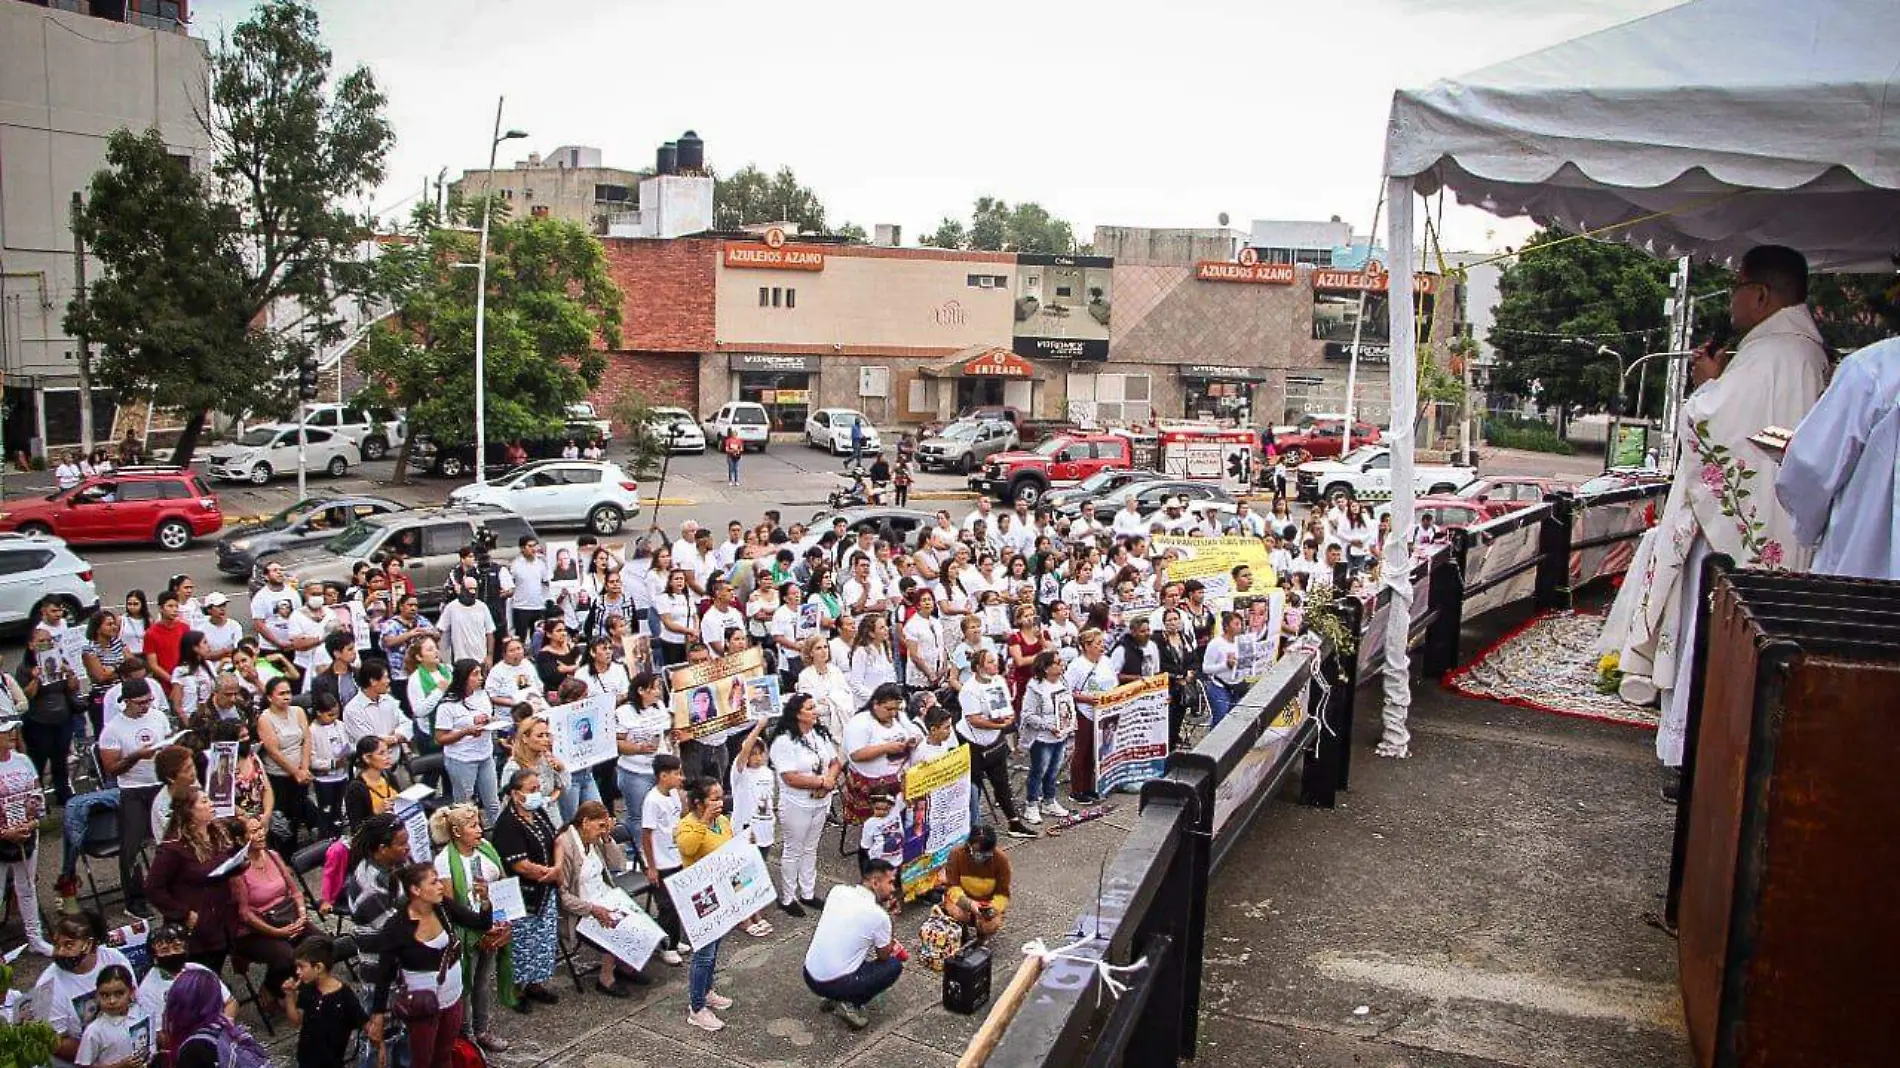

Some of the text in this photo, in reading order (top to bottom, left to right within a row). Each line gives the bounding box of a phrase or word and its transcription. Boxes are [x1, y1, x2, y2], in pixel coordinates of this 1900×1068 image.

[729, 249, 821, 264] AZULEJOS AZANO
[1201, 265, 1292, 280] AZULEJOS AZANO
[974, 364, 1023, 375] ENTRADA
